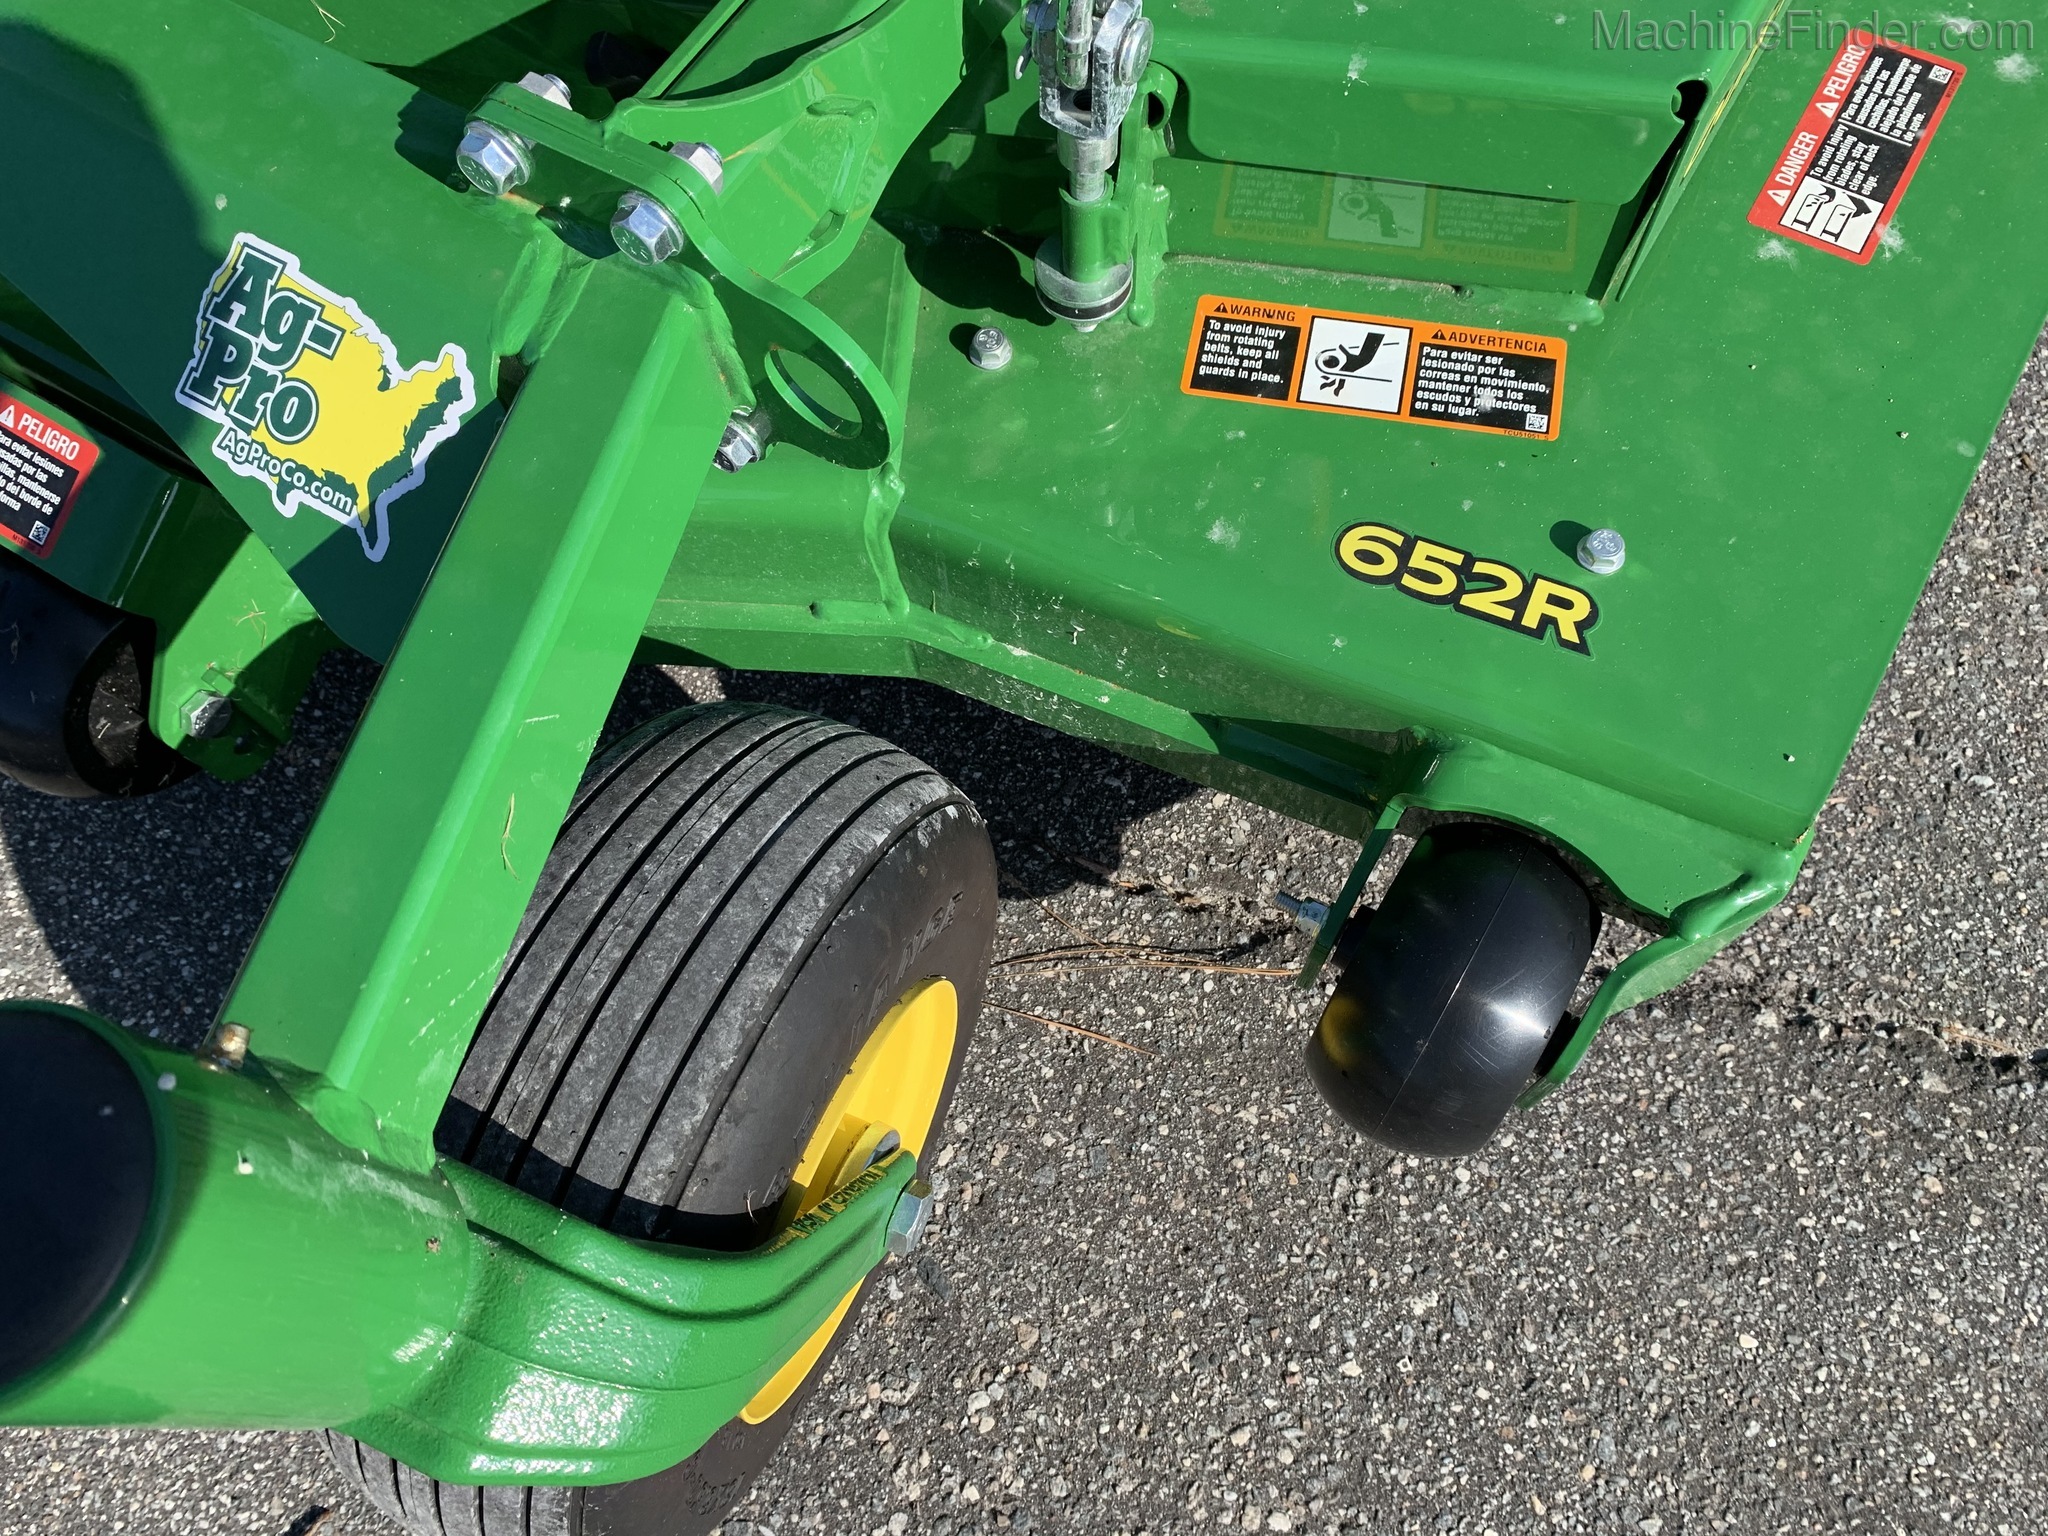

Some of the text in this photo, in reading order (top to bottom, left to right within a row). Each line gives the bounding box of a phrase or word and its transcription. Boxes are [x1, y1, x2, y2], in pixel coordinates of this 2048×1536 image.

[1823, 45, 1866, 98] PELIGRO
[1842, 56, 1884, 120] Para evitar lesiones
[1856, 70, 1891, 124] causadas por las
[1868, 58, 1911, 128] cuchillas, mantenerse
[1880, 64, 1922, 133] alejado del borde de
[1890, 92, 1921, 137] la plataforma
[1903, 113, 1927, 141] de corte.
[1775, 132, 1818, 186] DANGER
[1810, 124, 1849, 177] To avoid injury
[1823, 134, 1858, 182] from rotating
[1835, 141, 1868, 186] blades, stay
[1849, 144, 1880, 191] clear of deck
[1862, 175, 1879, 195] edge.
[207, 245, 345, 371] Ag-
[1230, 304, 1296, 322] WARNING
[1207, 331, 1274, 349] from rotating
[1210, 320, 1286, 339] To avoid injury
[1448, 332, 1547, 353] ADVERTENCIA
[1201, 353, 1262, 369] shields and
[1204, 342, 1279, 359] belts, keep all
[1421, 357, 1515, 377] lesionado por las
[1423, 346, 1503, 364] Para evitar ser
[182, 321, 318, 442] Pro
[1199, 365, 1283, 383] guards in place.
[1418, 379, 1524, 400] mantener todos los
[1420, 369, 1550, 394] correas en movimiento,
[1415, 401, 1479, 417] en su lugar.
[1417, 390, 1537, 413] escudos y protectores
[18, 412, 80, 460] PELIGRO
[11, 442, 33, 460] evitar
[32, 452, 64, 478] lesiones
[21, 461, 36, 476] por
[35, 468, 48, 483] las
[218, 430, 354, 514] AgProCo.com
[6, 479, 20, 496] del
[19, 488, 42, 509] borde
[41, 503, 53, 516] de
[17, 474, 61, 505] mantenerse
[1339, 525, 1591, 644] 652R
